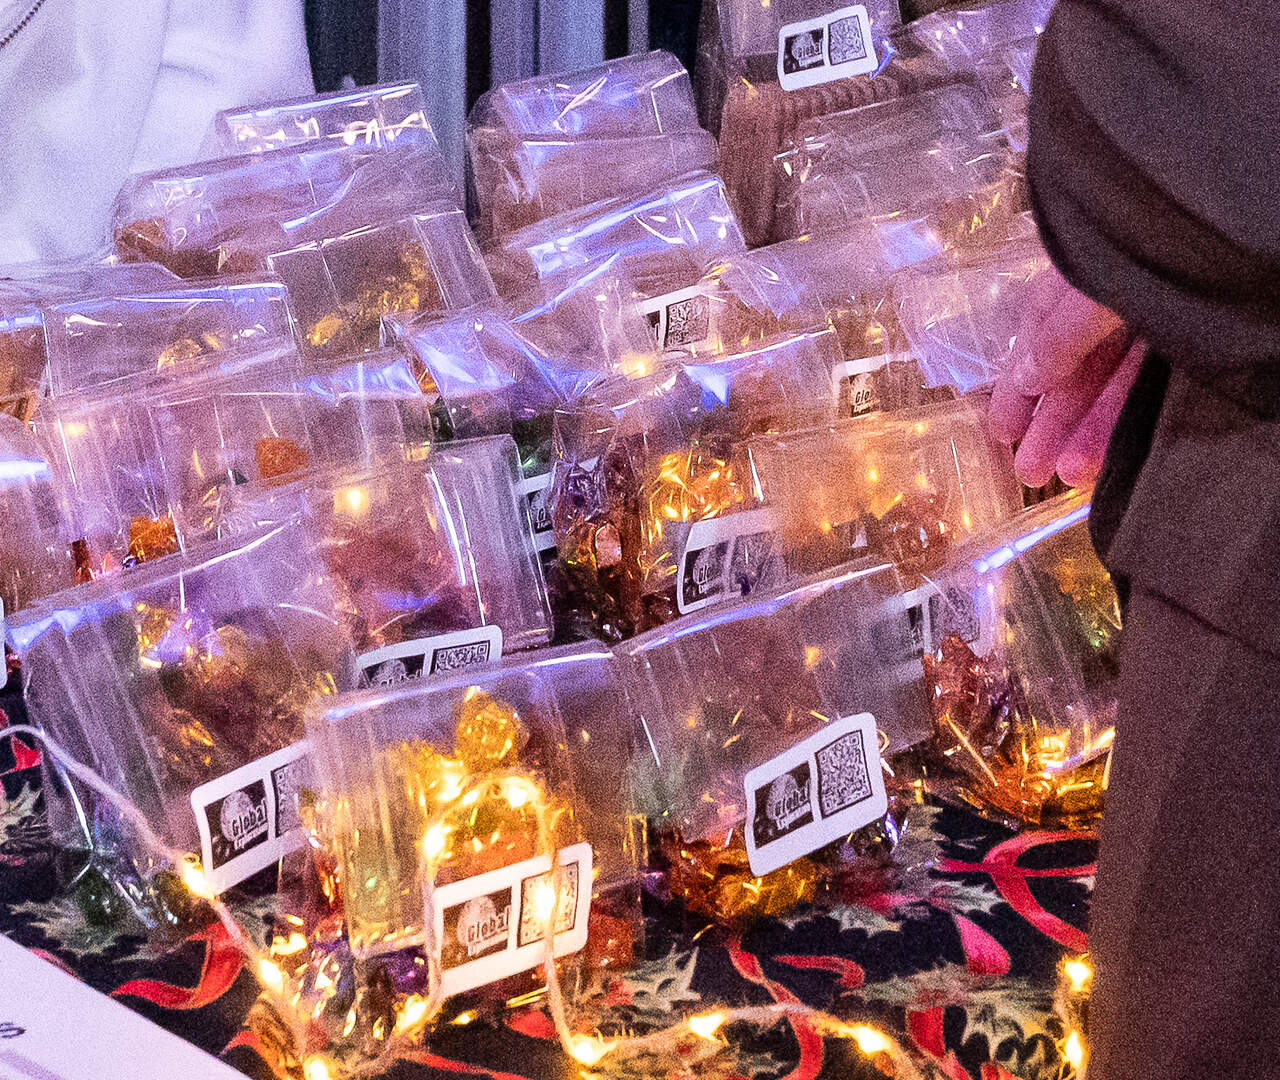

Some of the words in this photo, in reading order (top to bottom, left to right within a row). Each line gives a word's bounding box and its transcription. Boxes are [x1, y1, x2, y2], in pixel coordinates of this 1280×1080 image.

[231, 798, 269, 837] Global
[773, 778, 812, 818] Global
[467, 904, 513, 945] Global
